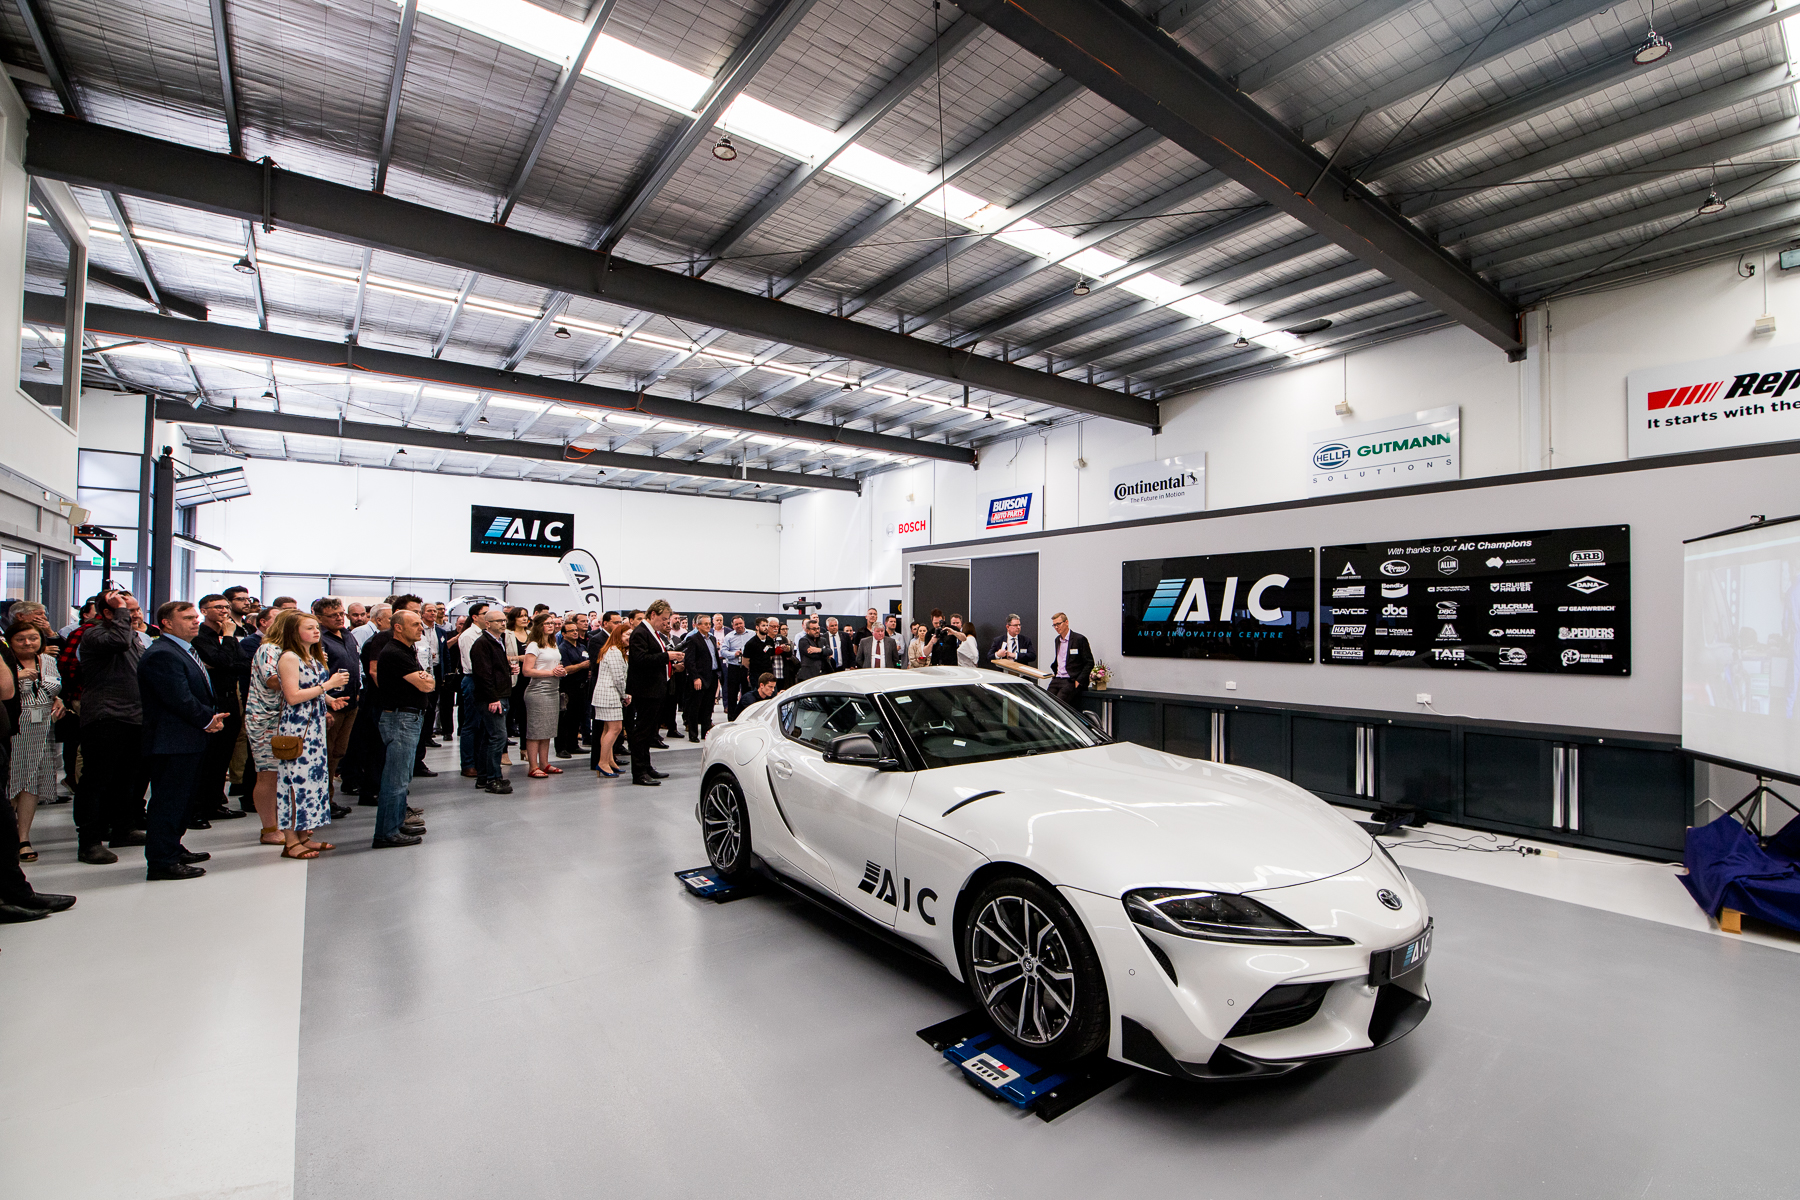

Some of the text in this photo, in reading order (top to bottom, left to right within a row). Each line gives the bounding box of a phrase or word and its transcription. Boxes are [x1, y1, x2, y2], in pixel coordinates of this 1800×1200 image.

[1647, 418, 1660, 429] It
[1665, 411, 1718, 427] starts
[1723, 404, 1765, 419] with
[1316, 432, 1451, 462] HELLA GUTMANN
[1312, 459, 1452, 484] SOLUTIONS
[1113, 473, 1186, 501] Continental
[992, 496, 1028, 512] BURSON
[1140, 493, 1158, 502] Future
[1165, 491, 1186, 499] Motion
[993, 509, 1024, 520] AUTO PARTS
[504, 517, 565, 542] AIC
[898, 519, 927, 534] BOSCH
[1387, 547, 1404, 556] With
[1405, 545, 1431, 555] thanks
[1432, 544, 1441, 553] to
[1458, 542, 1475, 551] AIC
[1477, 540, 1532, 550] Champions
[1574, 552, 1601, 560] ARB
[574, 573, 600, 605] AIC
[1173, 573, 1290, 622] AIC
[1382, 604, 1408, 615] dba
[1167, 630, 1232, 638] INNOVATION
[1238, 631, 1284, 639] CENTRE
[1570, 627, 1615, 640] PEDDERS
[1389, 649, 1416, 657] Repco
[1431, 648, 1465, 660] TAG
[875, 868, 938, 927] AIC
[1411, 932, 1430, 964] AIC
